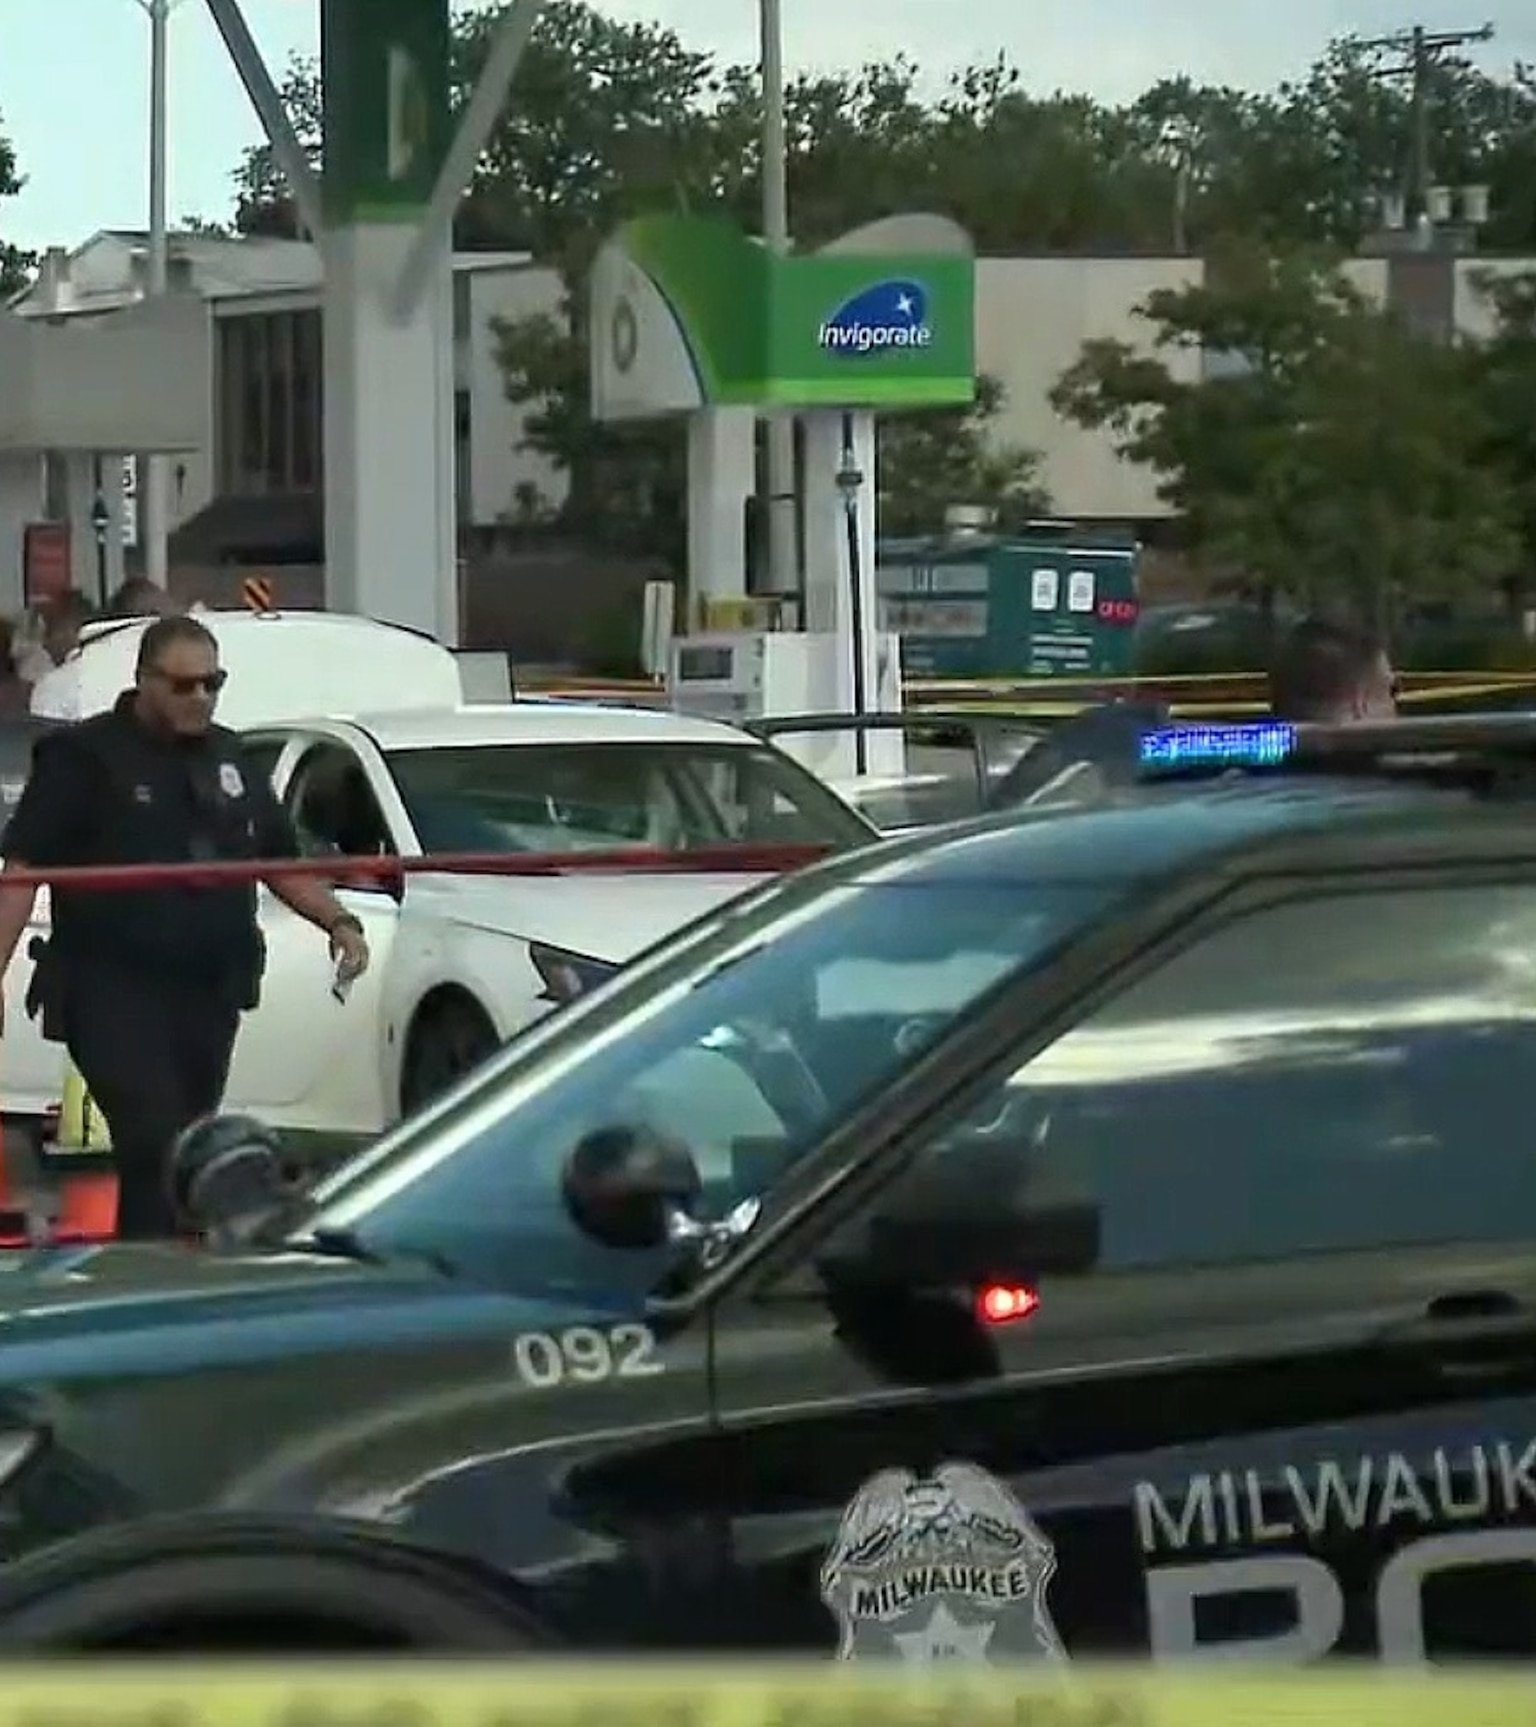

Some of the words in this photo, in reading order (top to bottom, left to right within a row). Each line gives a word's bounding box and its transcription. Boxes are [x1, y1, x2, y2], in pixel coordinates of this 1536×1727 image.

[818, 322, 931, 351] Invigorate
[516, 1323, 665, 1388] 092
[850, 1560, 1029, 1620] MILWAUKEE
